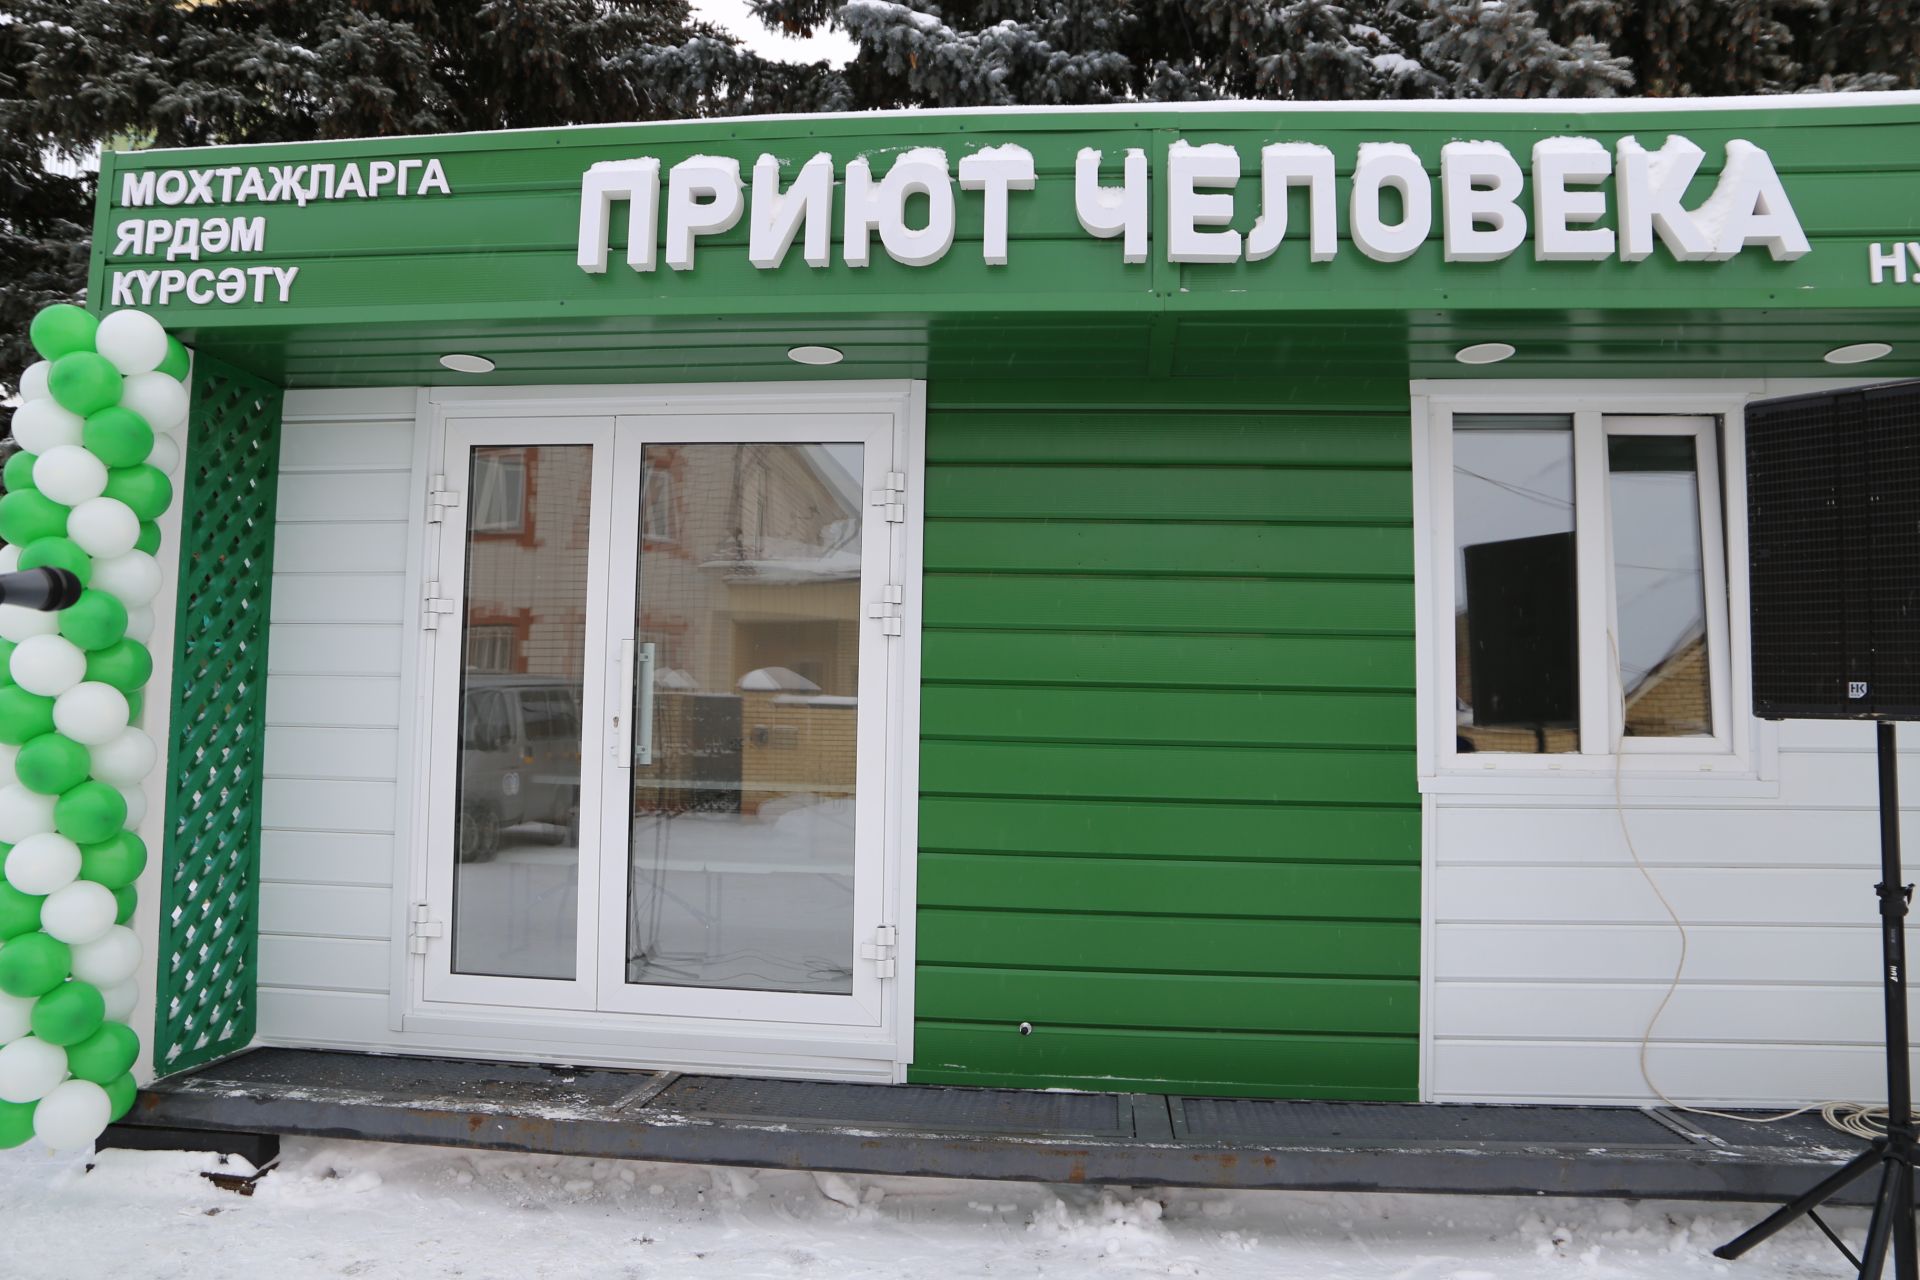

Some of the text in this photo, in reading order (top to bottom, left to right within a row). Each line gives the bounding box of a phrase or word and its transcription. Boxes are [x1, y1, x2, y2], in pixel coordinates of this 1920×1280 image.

[120, 158, 451, 207] МОХТАҖЛАРГА
[577, 134, 1812, 274] ПРИЮТ ЧЕЛОВЕКА
[112, 216, 266, 261] ЯРДӘМ
[110, 266, 299, 306] КҮРСӘТҮ
